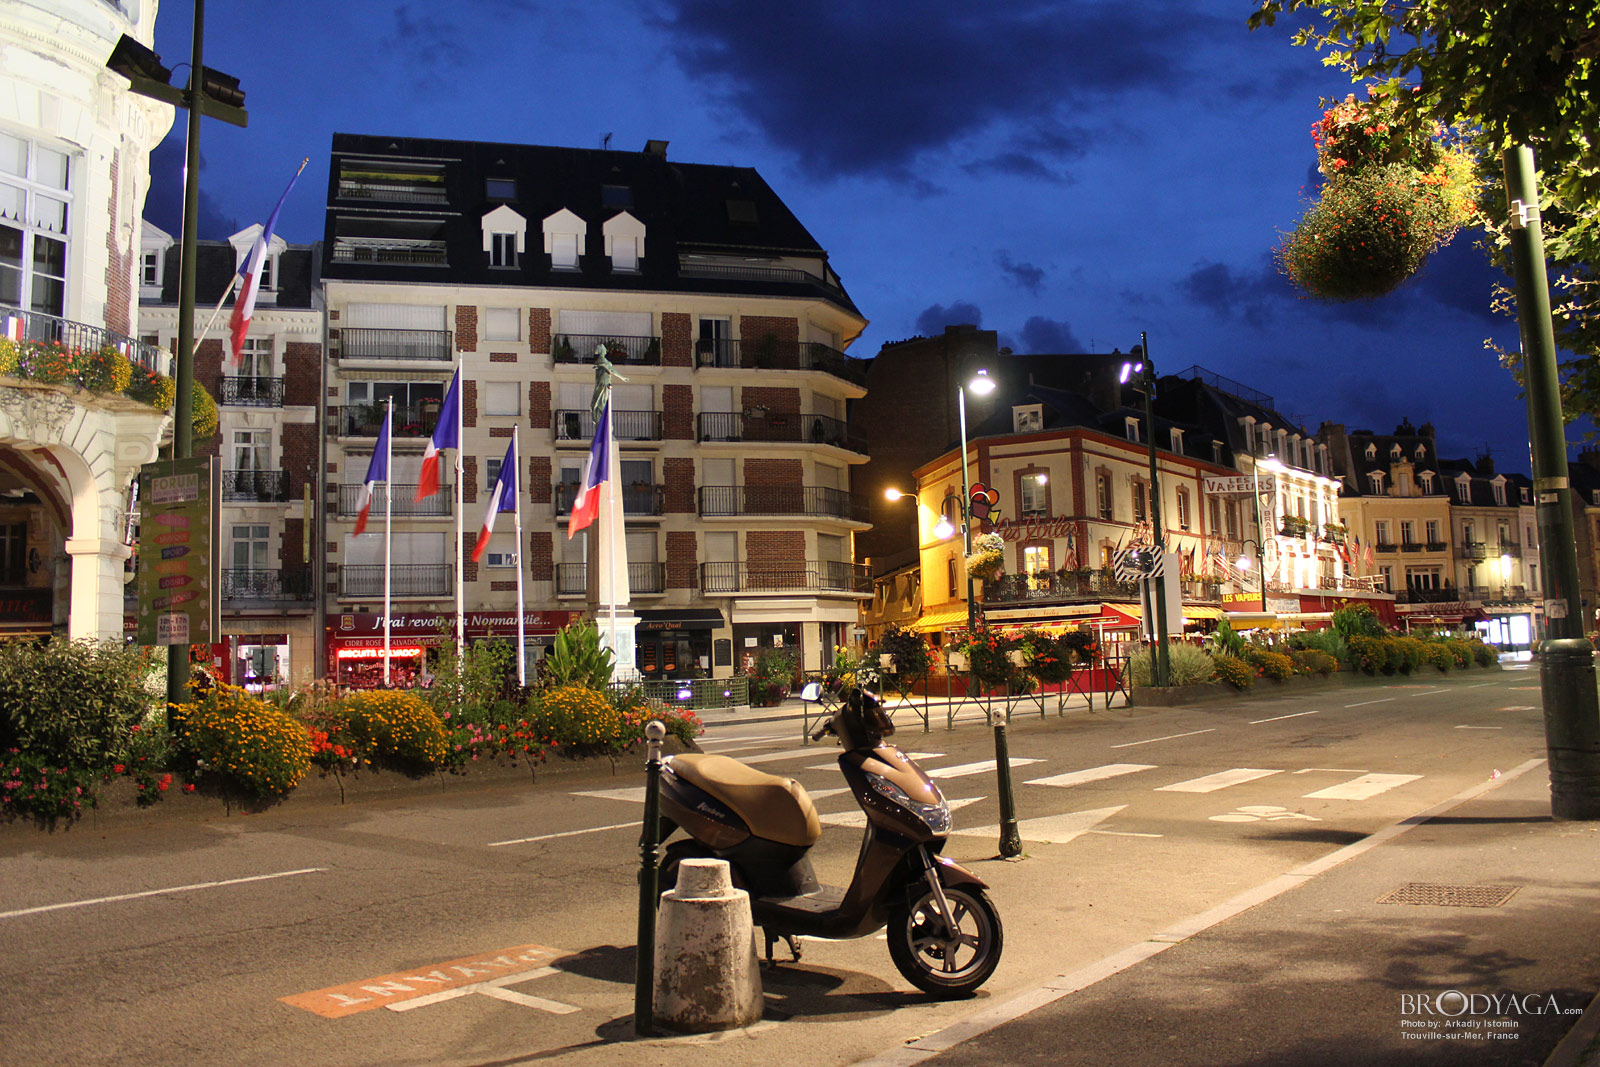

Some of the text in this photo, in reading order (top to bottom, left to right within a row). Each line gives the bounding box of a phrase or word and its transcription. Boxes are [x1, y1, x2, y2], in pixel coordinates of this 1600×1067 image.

[153, 475, 197, 491] FORUM
[1206, 477, 1273, 492] VAPEURS
[996, 514, 1080, 543] Les Voiles
[1264, 510, 1274, 562] BRASSERIE
[1222, 592, 1262, 603] LES VAPEURS
[365, 639, 381, 647] ROSÉ
[384, 638, 419, 647] ALVADO
[338, 648, 420, 658] BISCUITS CLVADOS
